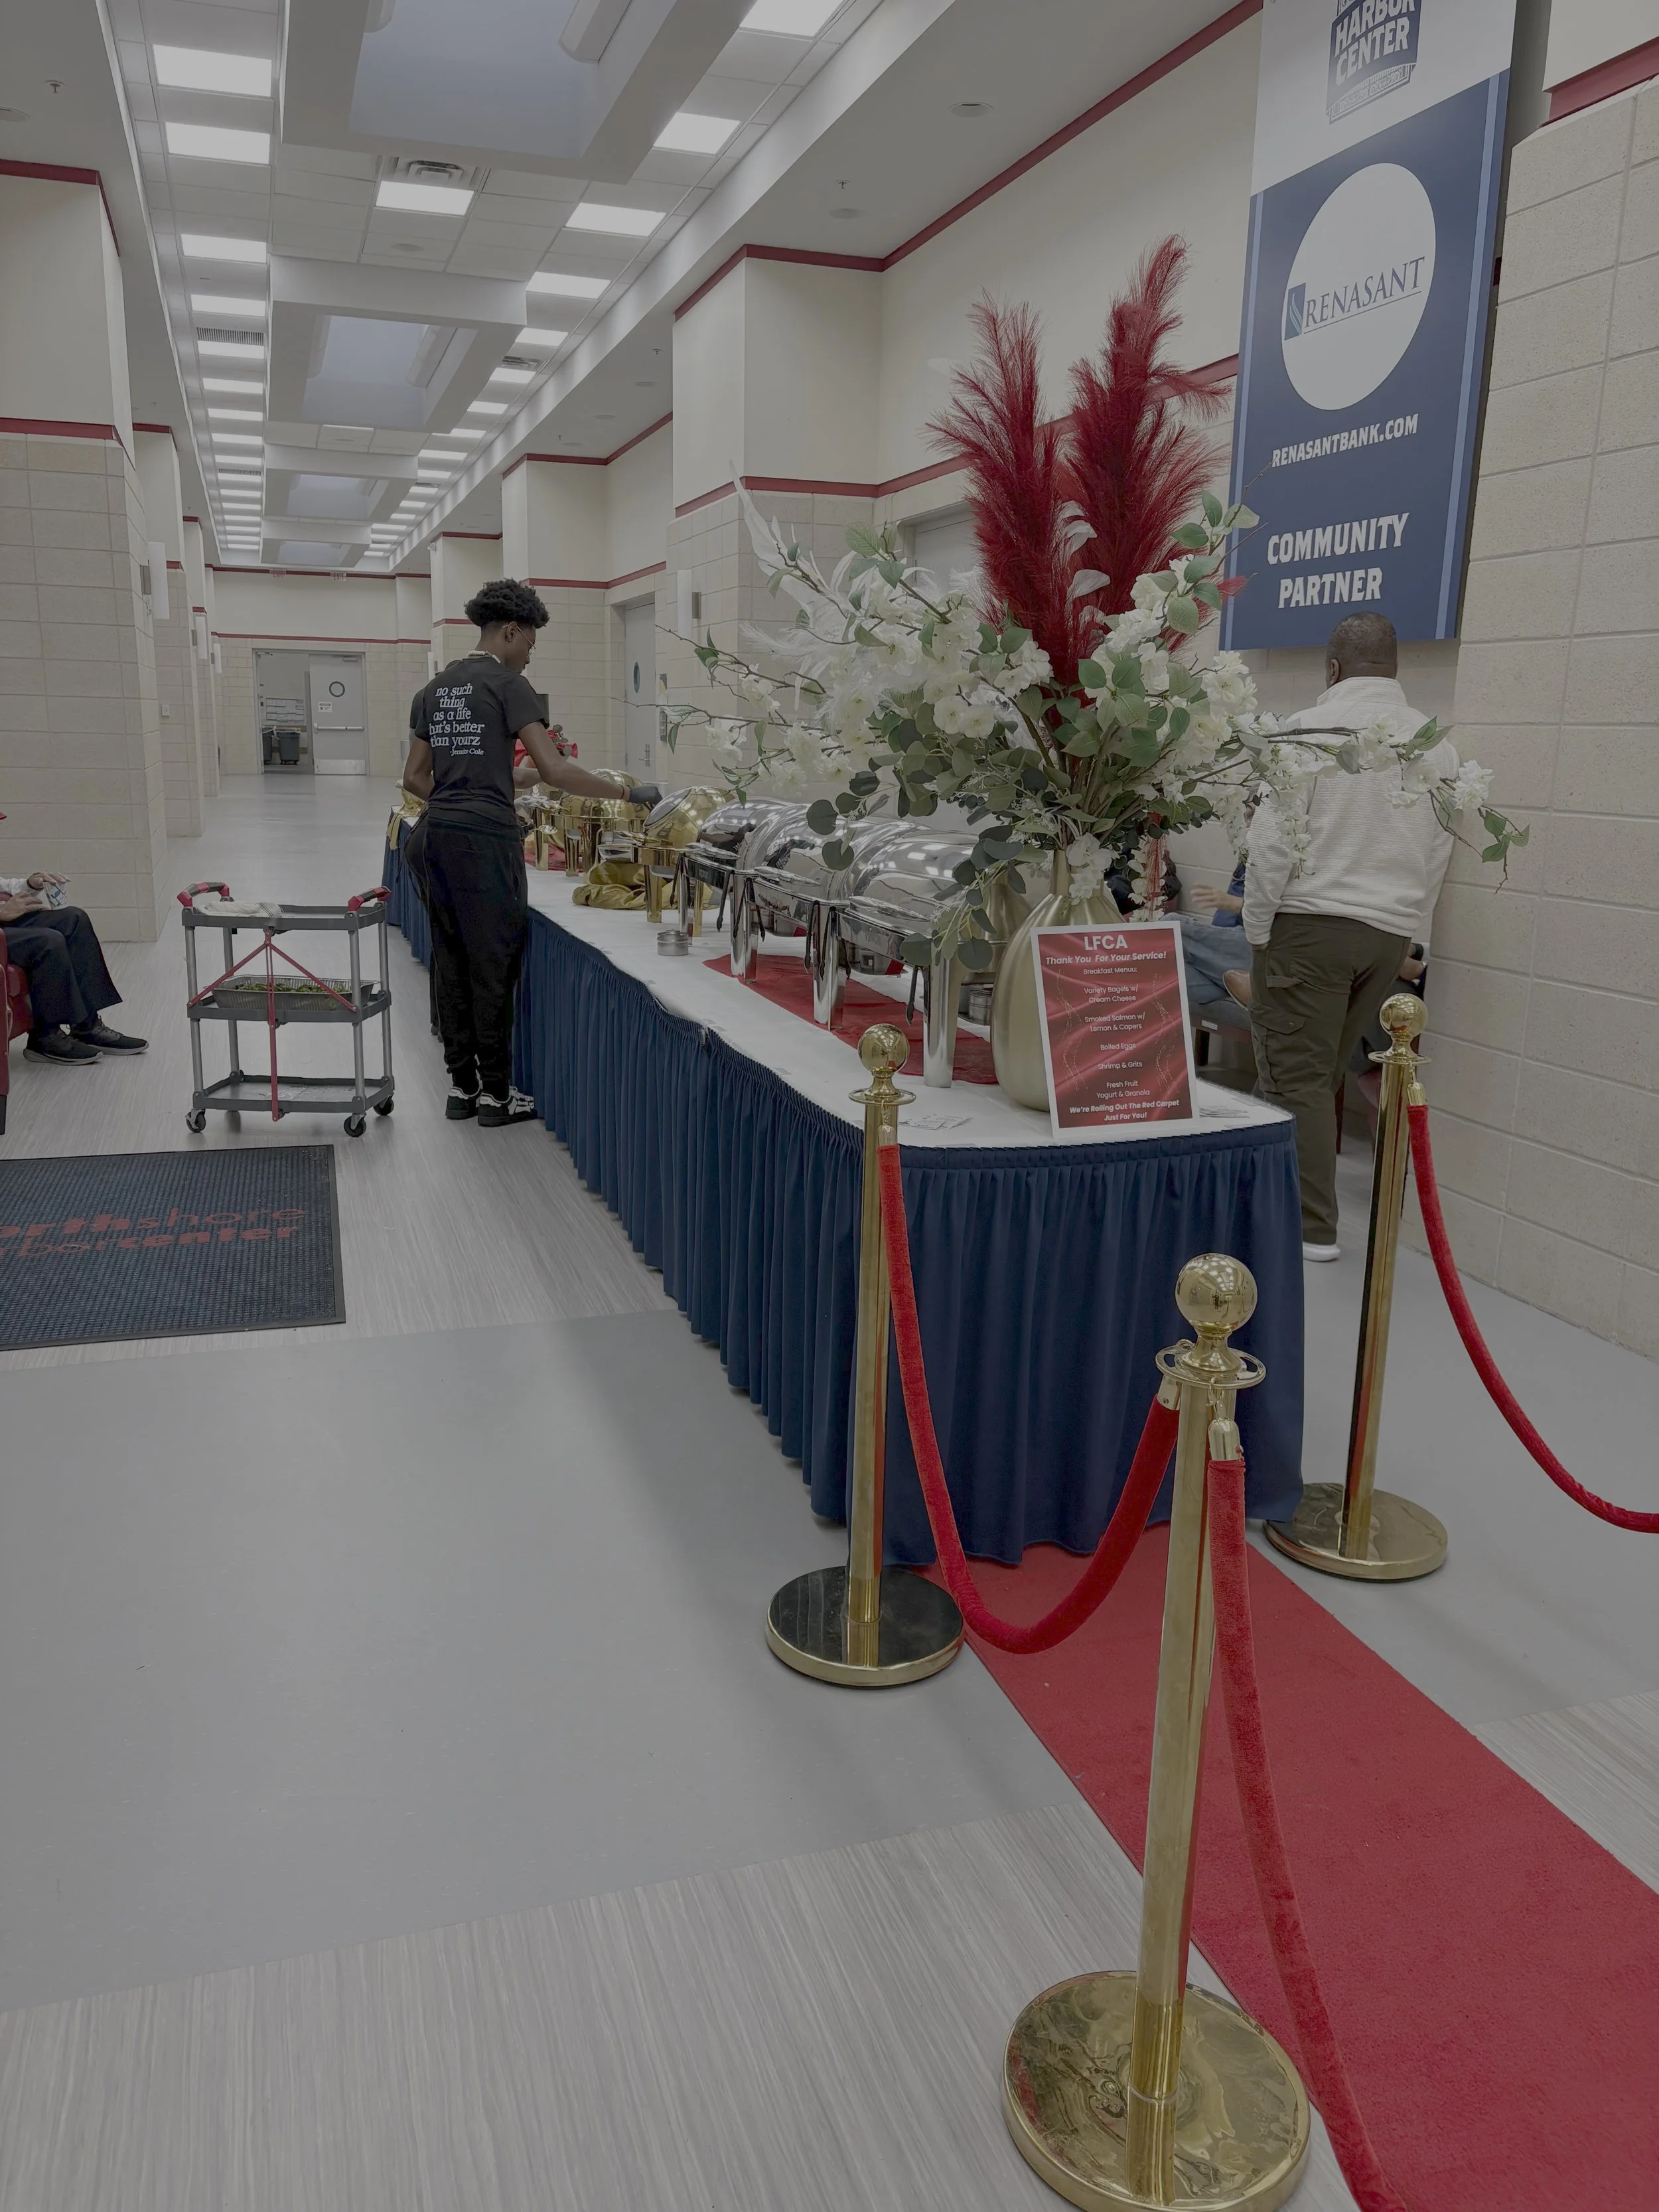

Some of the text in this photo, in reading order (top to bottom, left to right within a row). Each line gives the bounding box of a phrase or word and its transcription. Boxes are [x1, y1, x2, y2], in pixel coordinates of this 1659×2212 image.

[1336, 17, 1409, 86] CENTER
[1304, 256, 1425, 329] RENASANT
[1271, 413, 1418, 468] RENASANTBANK.COM
[1267, 512, 1409, 565] COMMUNITY
[1278, 567, 1384, 609] PARTNER
[435, 683, 472, 696] no such
[440, 696, 465, 709] thing
[433, 707, 471, 721] as a life
[453, 721, 485, 733] better
[1084, 934, 1127, 950] LFCA
[1110, 953, 1130, 962] Your
[1132, 952, 1167, 960] Service!
[1084, 986, 1106, 995] Variety
[1108, 985, 1128, 994] Bagels
[1091, 1104, 1114, 1113] Rolling
[1156, 1100, 1179, 1108] Carpet
